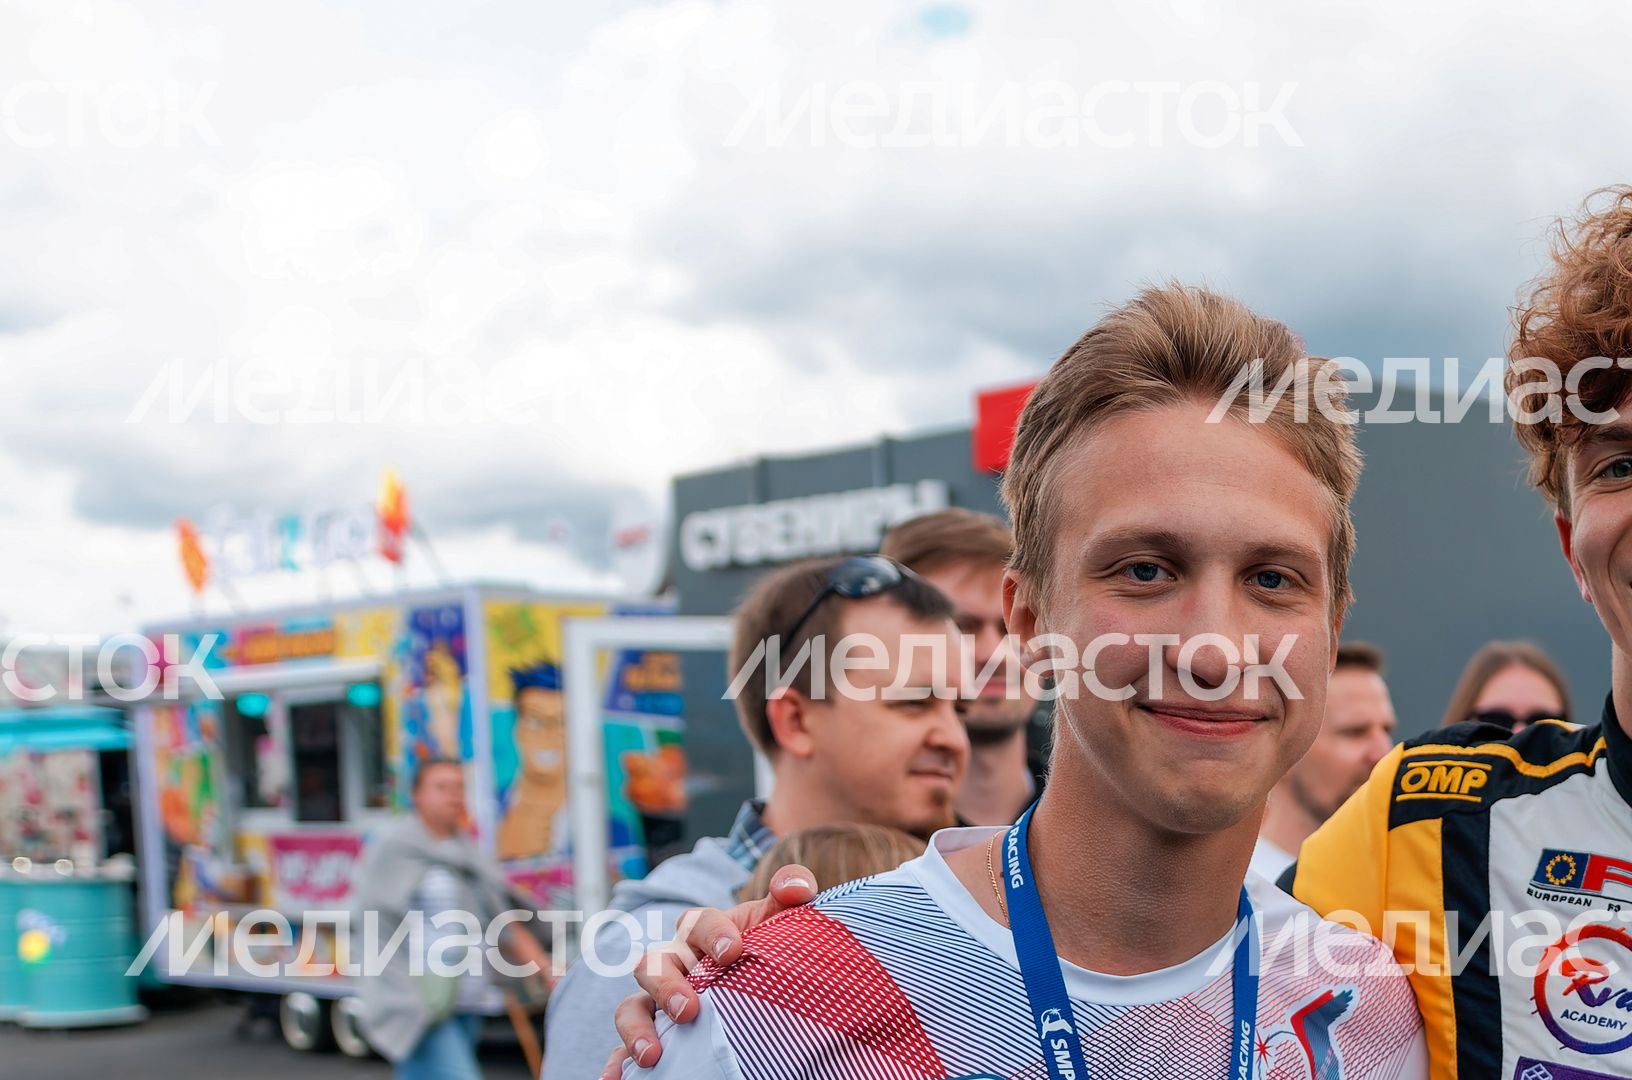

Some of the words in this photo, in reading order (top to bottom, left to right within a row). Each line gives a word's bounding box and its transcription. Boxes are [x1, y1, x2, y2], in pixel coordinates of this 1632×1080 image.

[1400, 765, 1488, 794] OMP
[1007, 825, 1024, 889] RACING
[1526, 887, 1593, 907] EUROPEAN
[1560, 1008, 1628, 1031] ACADEMY
